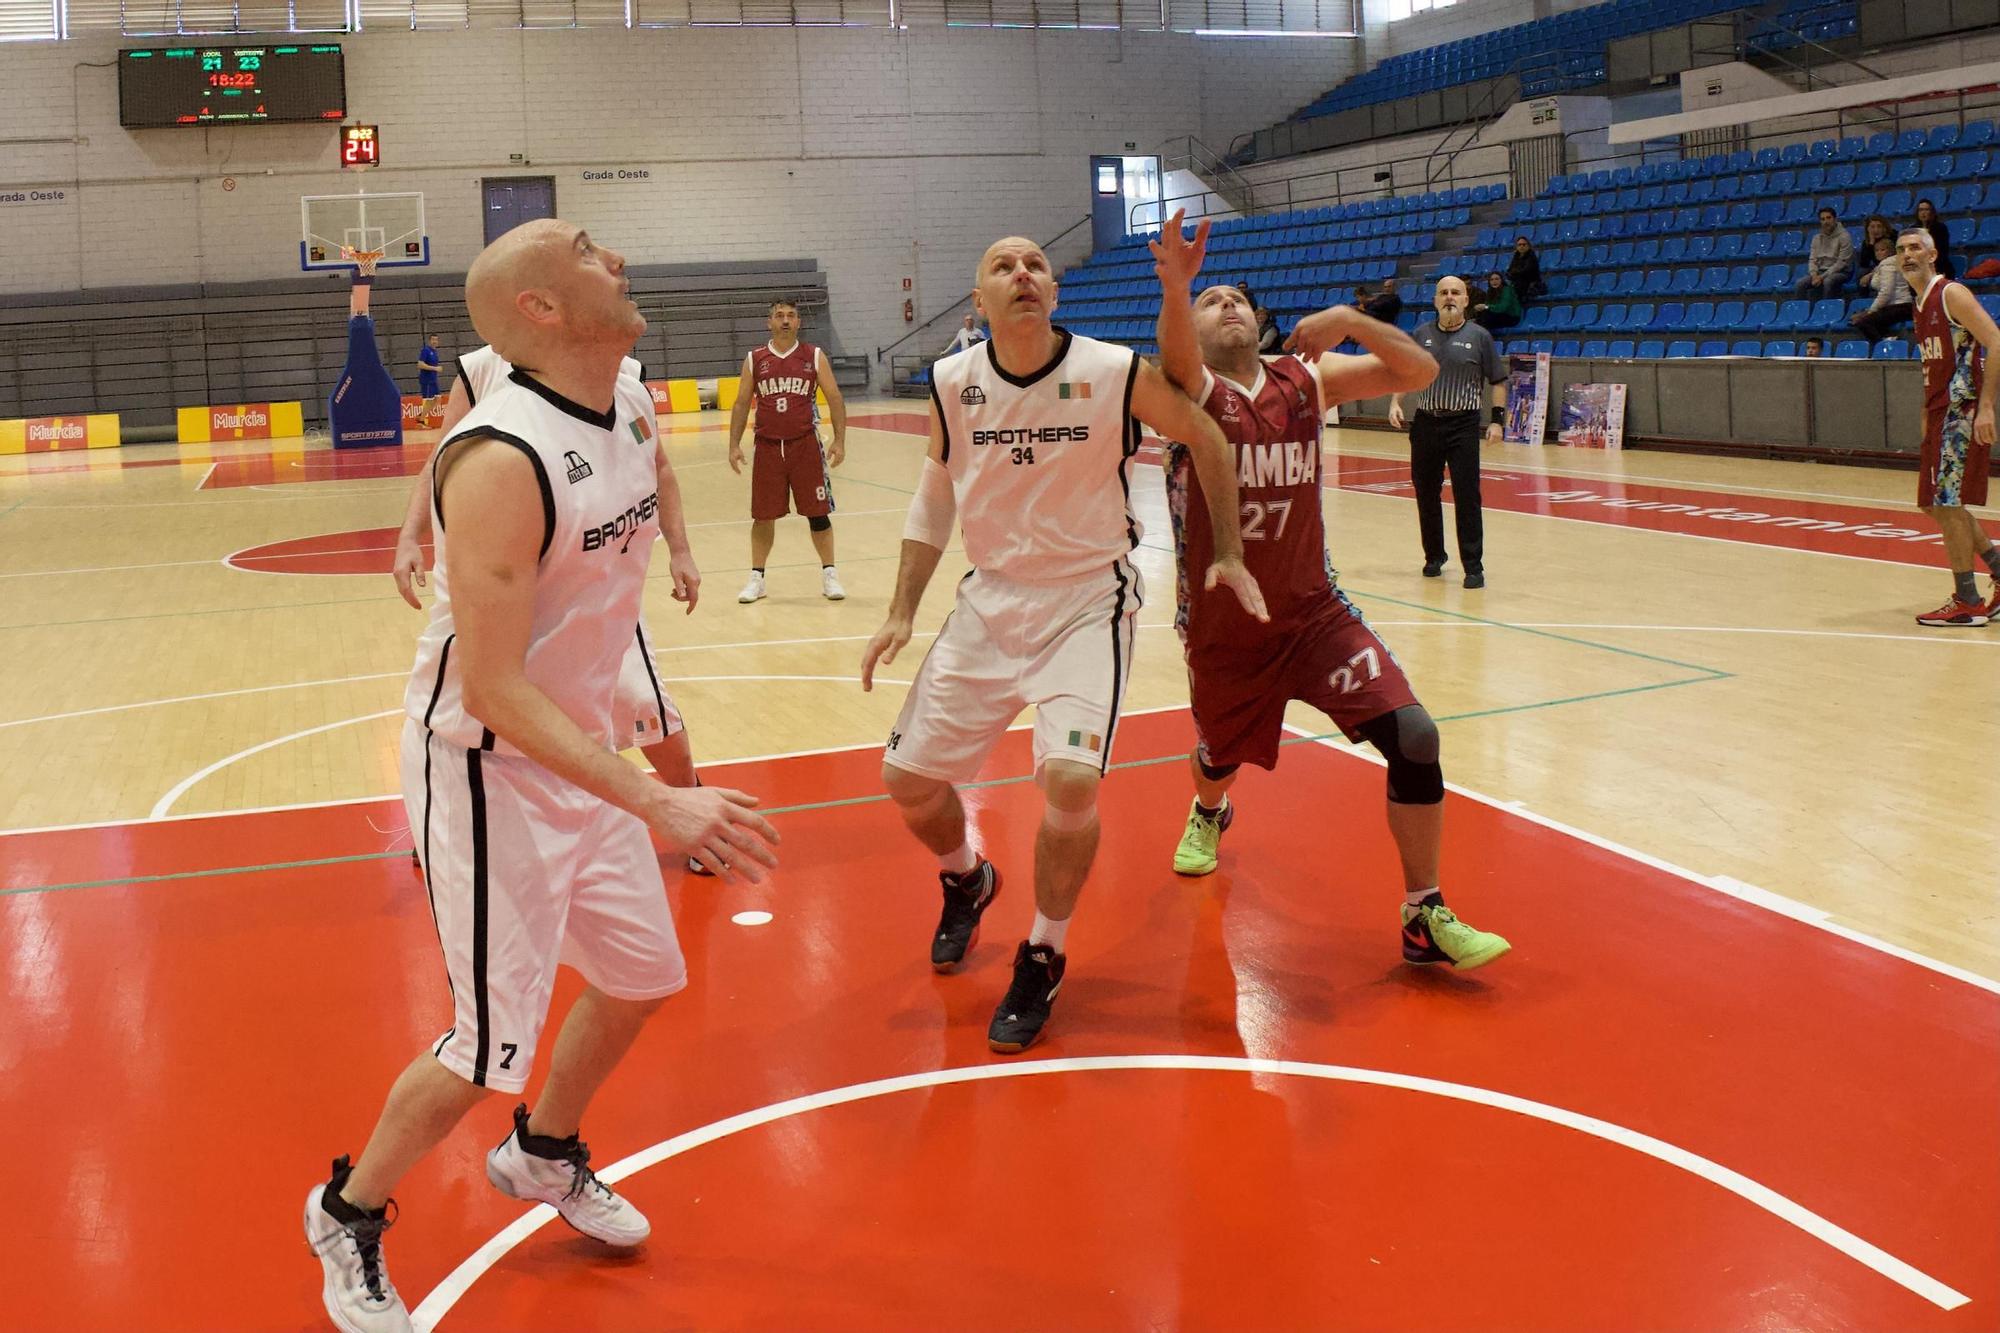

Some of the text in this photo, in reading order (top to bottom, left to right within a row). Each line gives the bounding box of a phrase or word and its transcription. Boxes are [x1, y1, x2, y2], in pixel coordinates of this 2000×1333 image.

[203, 57, 260, 70] 21 23
[209, 73, 255, 87] 18:22
[346, 140, 374, 161] 24
[582, 169, 650, 180] Grada Oeste
[0, 190, 65, 202] rada Oeste
[757, 377, 811, 398] MAMBA
[401, 403, 447, 419] Mucia
[775, 397, 788, 413] 8
[213, 410, 267, 429] Murcia
[30, 422, 84, 441] Murcia
[972, 426, 1089, 446] BROTHERS
[1011, 447, 1034, 465] 34
[816, 485, 827, 501] 8
[582, 491, 659, 552] BROTHER
[1240, 498, 1294, 541] 27
[620, 528, 638, 555] 7
[1328, 646, 1382, 696] 27
[500, 1042, 518, 1070] 7
